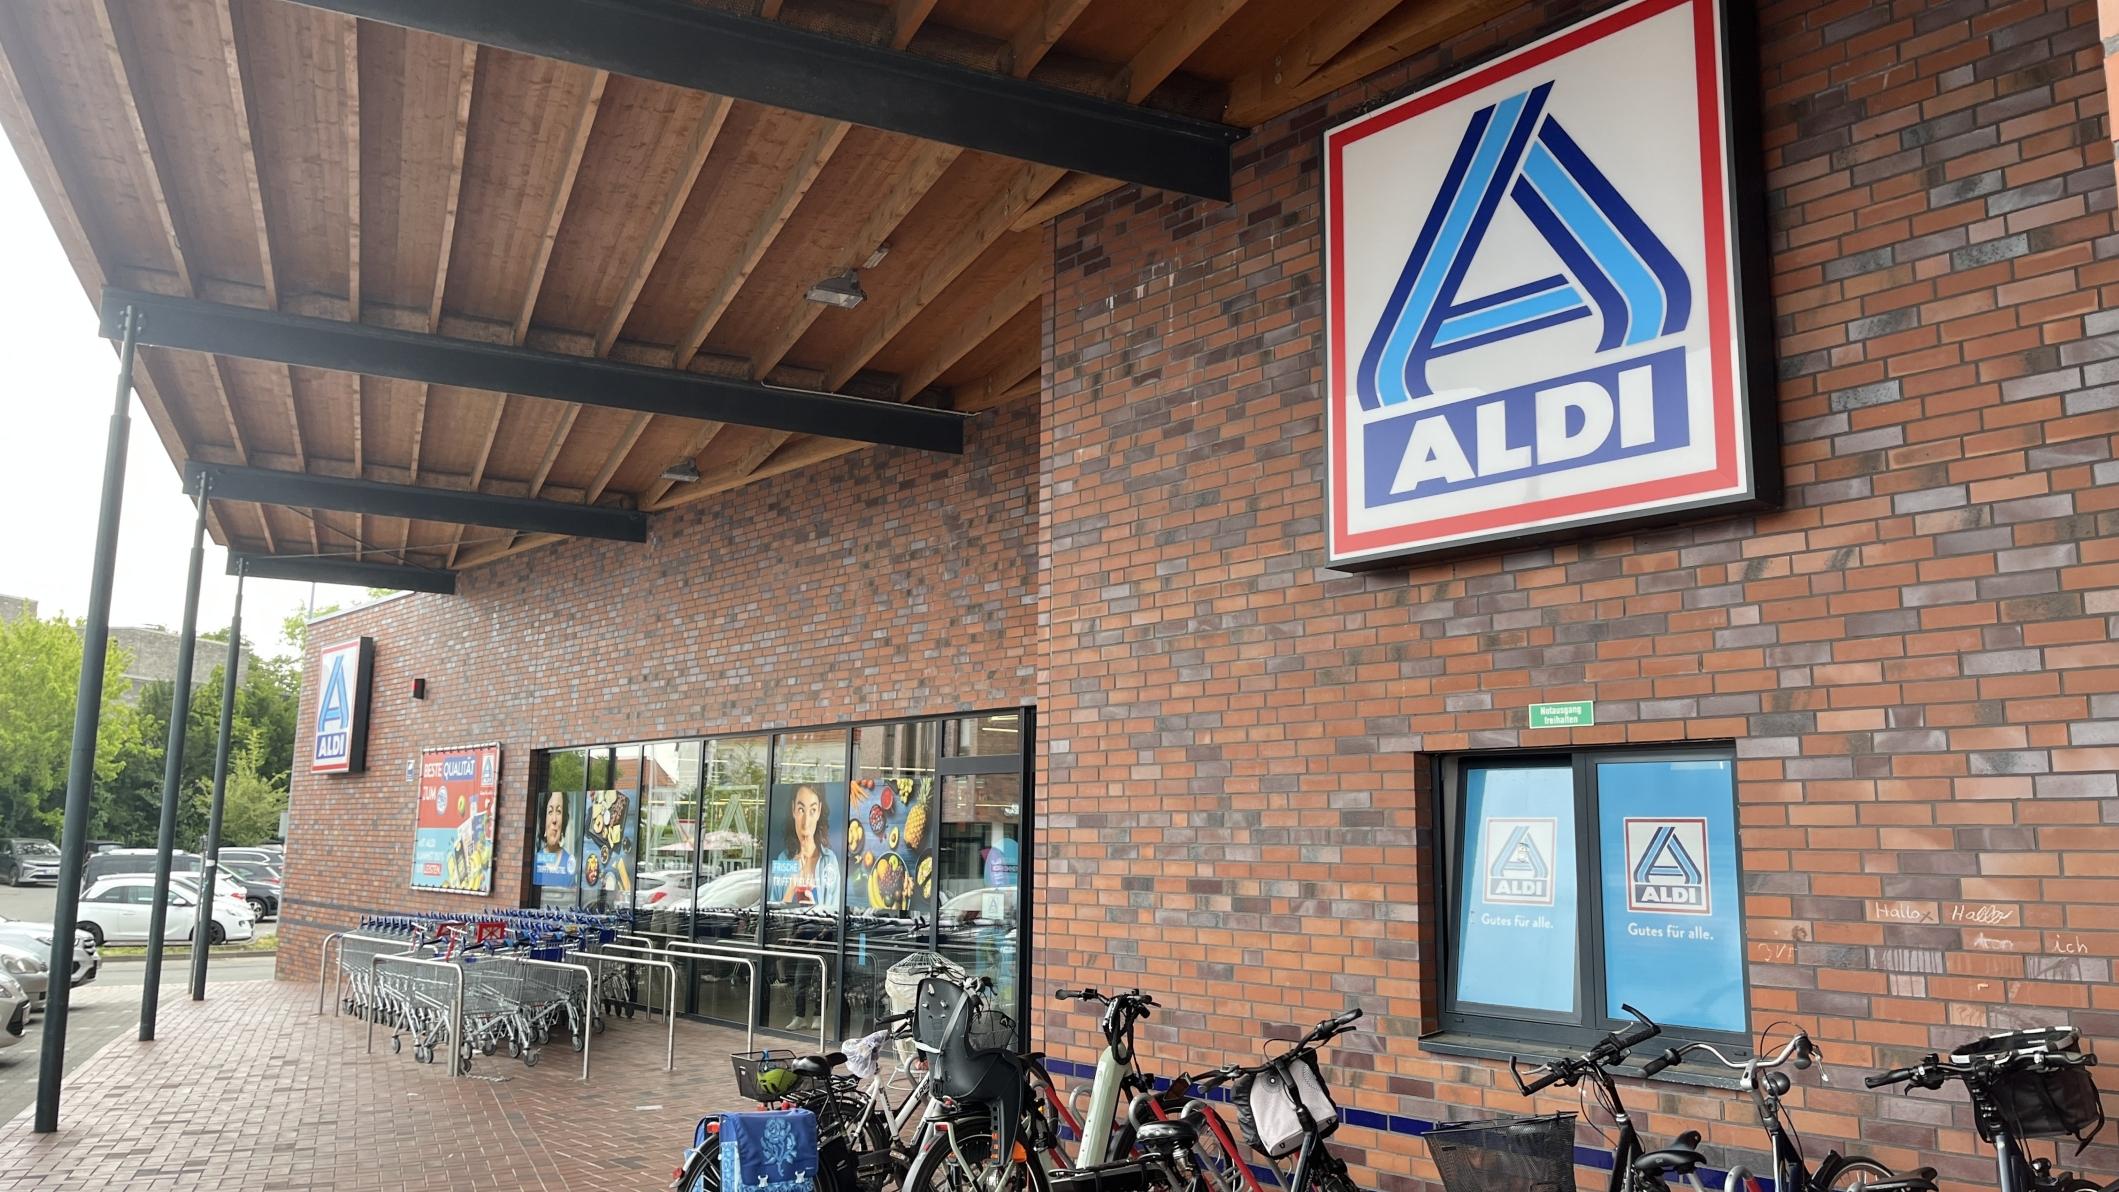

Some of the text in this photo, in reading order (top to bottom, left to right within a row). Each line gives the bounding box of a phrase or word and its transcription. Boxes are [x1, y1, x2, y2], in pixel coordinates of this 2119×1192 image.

[1389, 364, 1655, 495] ALDI
[1540, 706, 1582, 715] Notausgang
[1544, 715, 1579, 724] freihalten
[318, 733, 345, 758] ALDI
[424, 762, 442, 777] BESTE
[443, 756, 475, 780] QUALITÄT
[773, 862, 798, 873] FRISCHE
[1495, 880, 1543, 895] ALDI
[1641, 886, 1697, 903] ALDI
[1875, 901, 1921, 920] Hallo
[1481, 913, 1554, 929] Gutes für alle.
[1627, 922, 1714, 940] Gutes für alle.
[2052, 934, 2088, 954] ich
